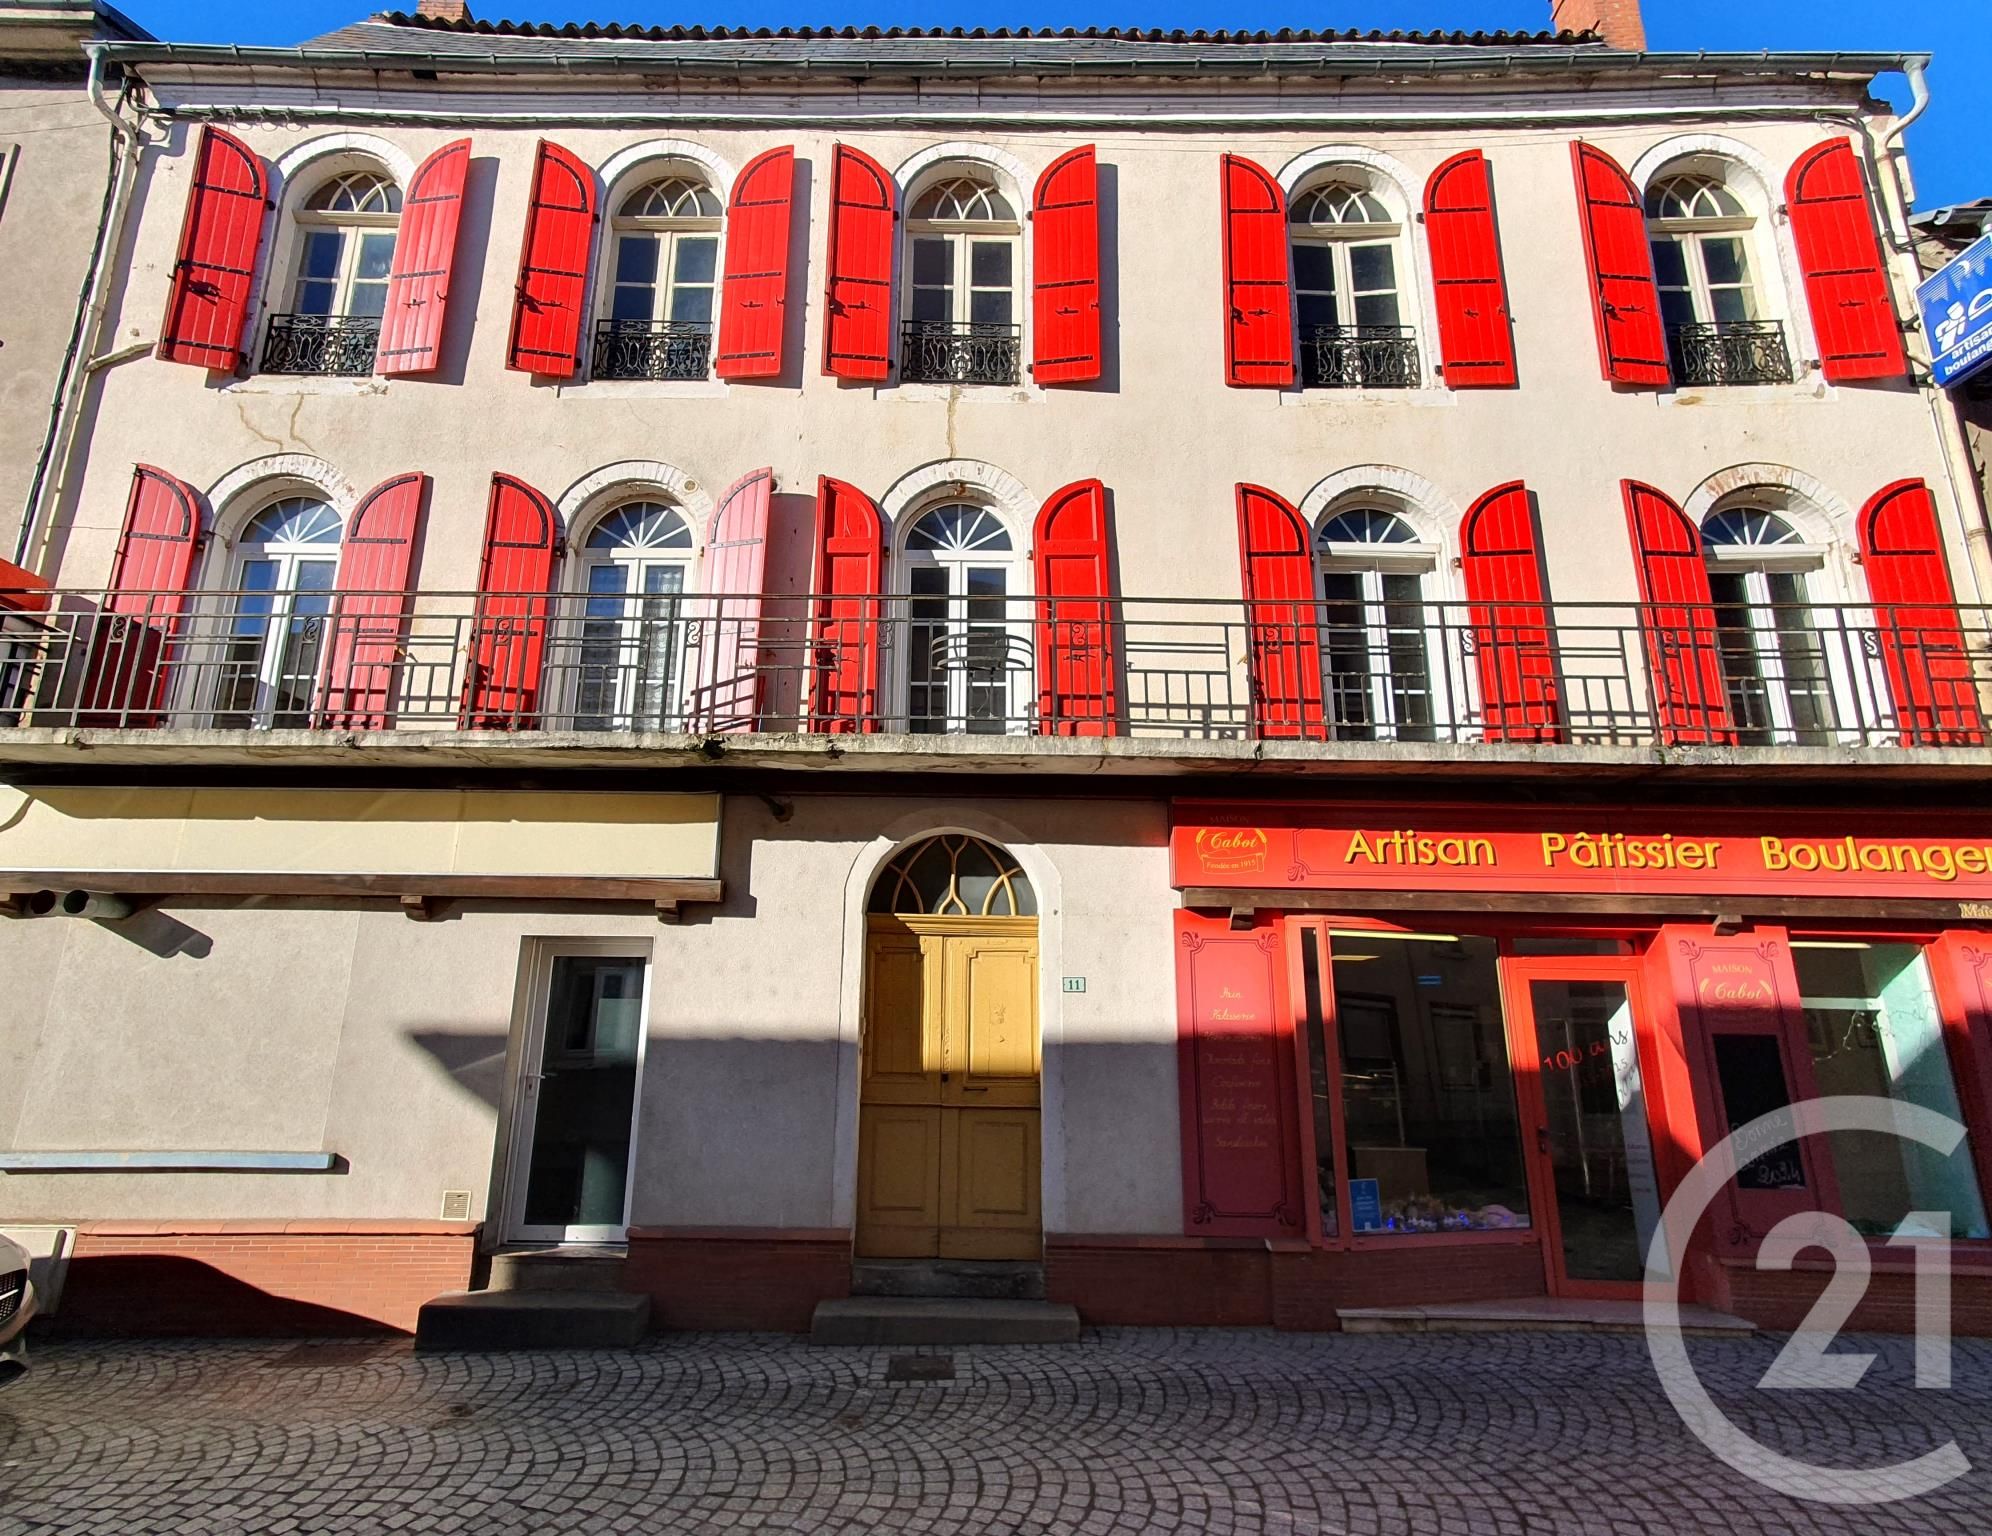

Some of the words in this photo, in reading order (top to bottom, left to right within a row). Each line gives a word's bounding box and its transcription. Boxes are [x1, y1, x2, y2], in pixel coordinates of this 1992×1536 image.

[1202, 831, 1260, 852] Cabot
[1344, 829, 1497, 866] Artisan
[1541, 831, 1722, 870] Pâtissier
[1711, 964, 1753, 975] MAISON
[1068, 979, 1080, 990] 11
[1714, 981, 1763, 1000] Cabot
[1543, 1047, 1583, 1072] 100
